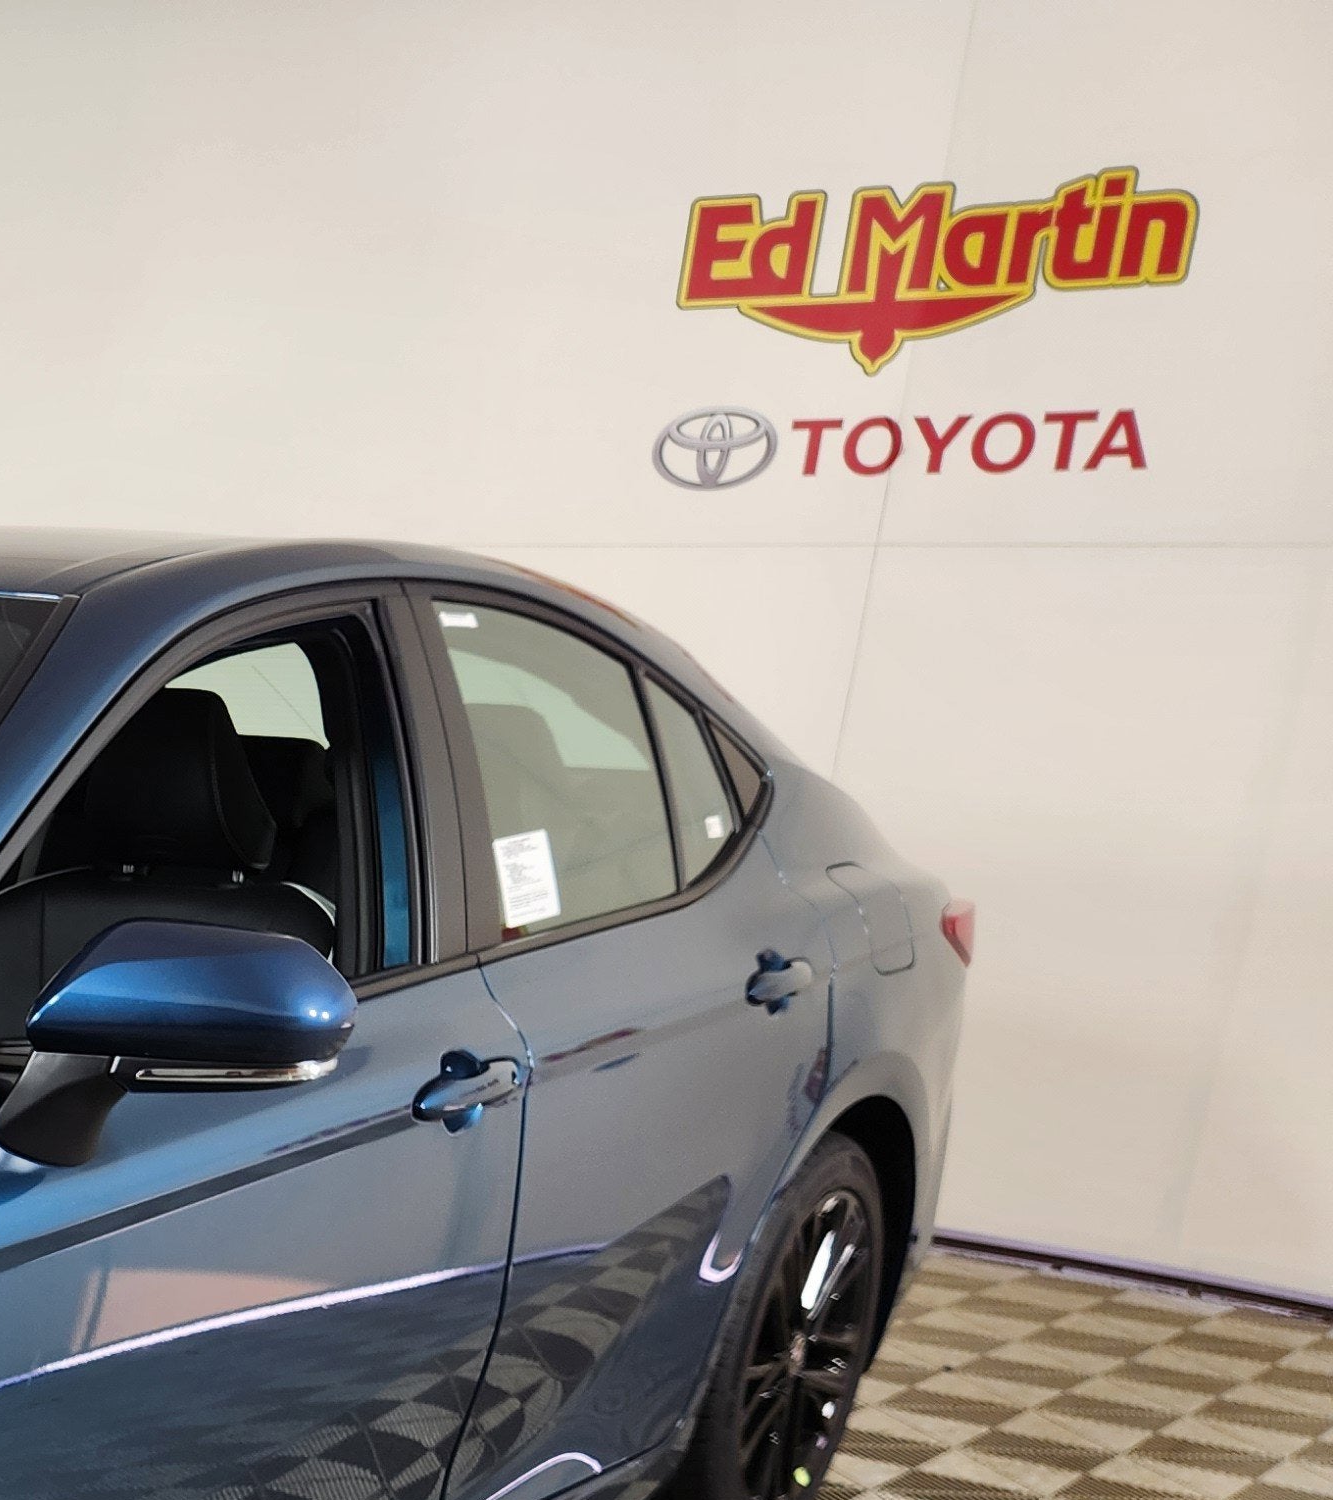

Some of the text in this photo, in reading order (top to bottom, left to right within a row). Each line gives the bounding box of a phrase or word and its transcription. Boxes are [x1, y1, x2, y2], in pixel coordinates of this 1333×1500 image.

[678, 168, 1197, 308] Ed Martin
[791, 408, 1148, 477] TOYOTA
